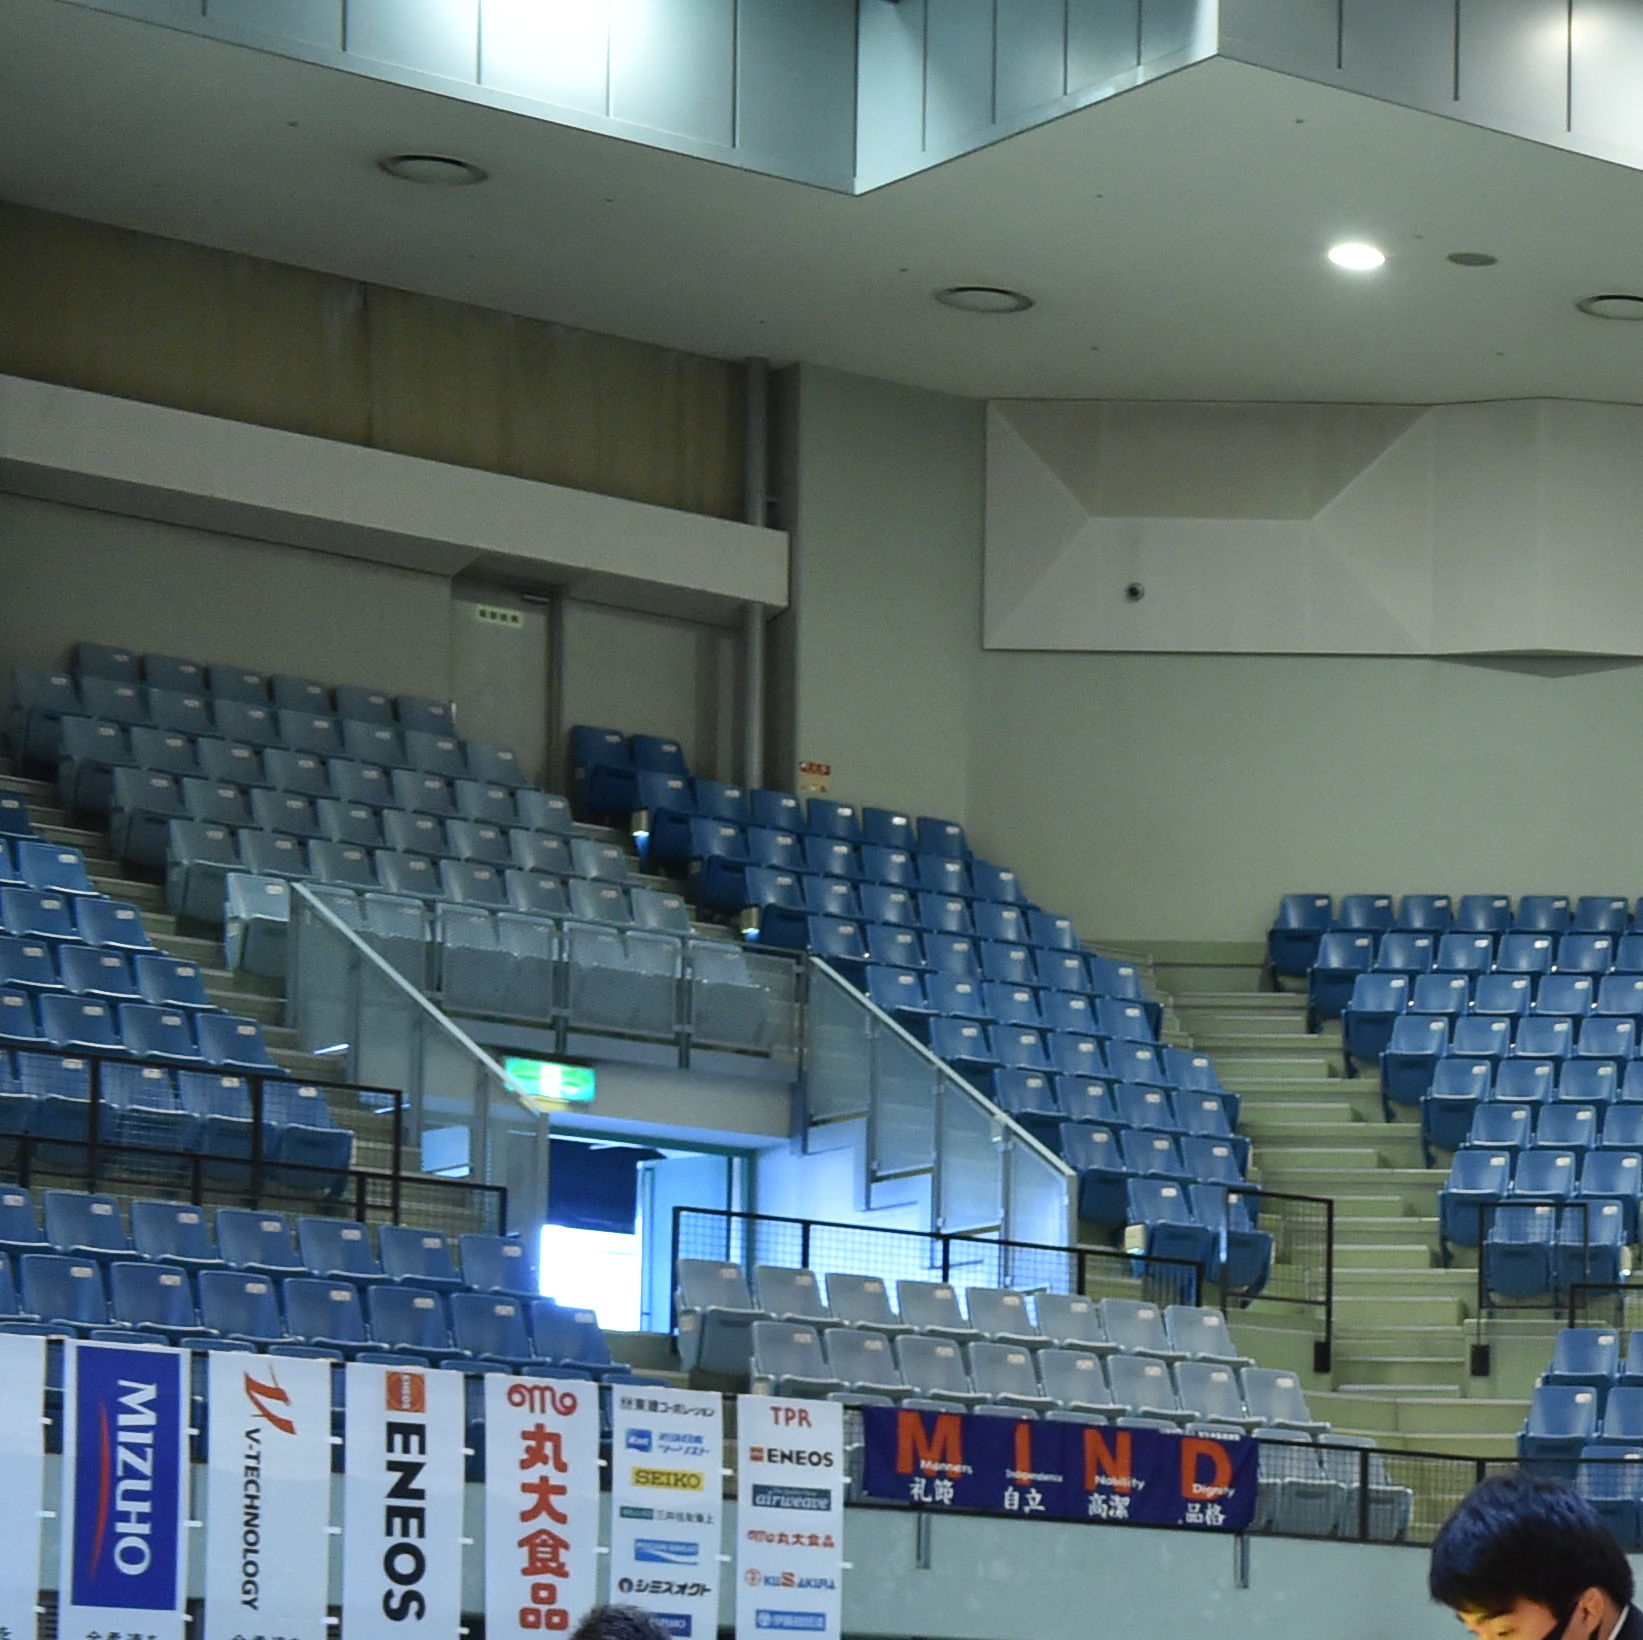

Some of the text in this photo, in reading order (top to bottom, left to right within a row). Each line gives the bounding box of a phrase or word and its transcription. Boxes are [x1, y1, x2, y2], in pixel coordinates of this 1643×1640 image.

[770, 1406, 812, 1428] TPR
[766, 1448, 834, 1467] ENEOS
[114, 1379, 158, 1575] MIZUHO
[634, 1470, 701, 1489] SEIKO
[909, 1476, 955, 1505] 礼節
[755, 1491, 829, 1508] airweave
[1003, 1485, 1046, 1514] 自立
[1185, 1502, 1227, 1526] 品格
[241, 1427, 262, 1611] V-TECHNOLOGY
[382, 1421, 427, 1622] ENEOS
[517, 1423, 570, 1631] 丸大食品
